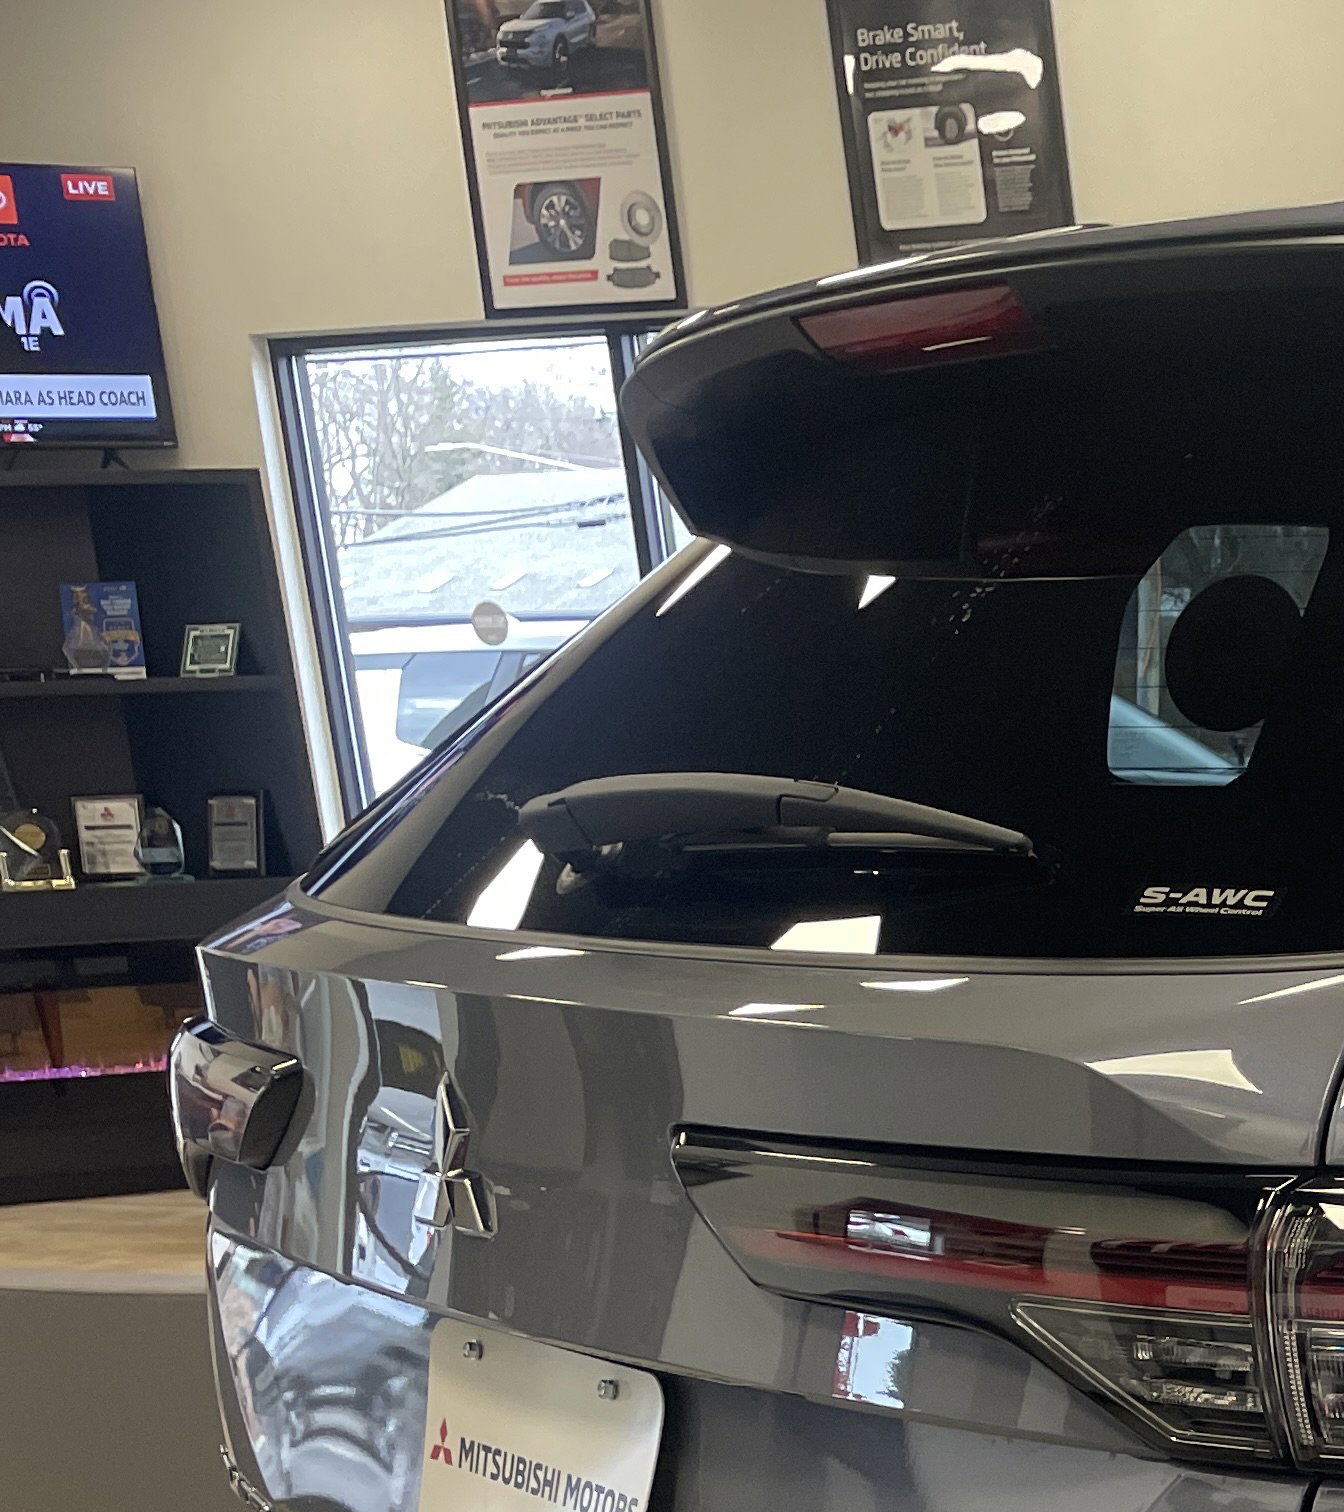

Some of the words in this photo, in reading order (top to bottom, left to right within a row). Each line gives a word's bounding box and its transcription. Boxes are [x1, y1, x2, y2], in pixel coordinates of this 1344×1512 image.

[857, 26, 904, 47] Brake
[906, 19, 965, 41] Smart,
[859, 50, 903, 71] Drive
[584, 111, 614, 123] SELECT
[615, 109, 643, 120] PARTS
[67, 180, 109, 195] LIVE
[0, 390, 34, 406] ARA
[37, 390, 55, 406] AS
[57, 390, 96, 406] HEAD
[99, 390, 147, 407] COACH
[1139, 886, 1275, 908] S-AWC
[1133, 904, 1167, 913] Super
[1167, 905, 1184, 913] All
[1185, 906, 1218, 915] Wheel
[1219, 907, 1264, 916] Control
[458, 1436, 562, 1504] MITSUBISHI
